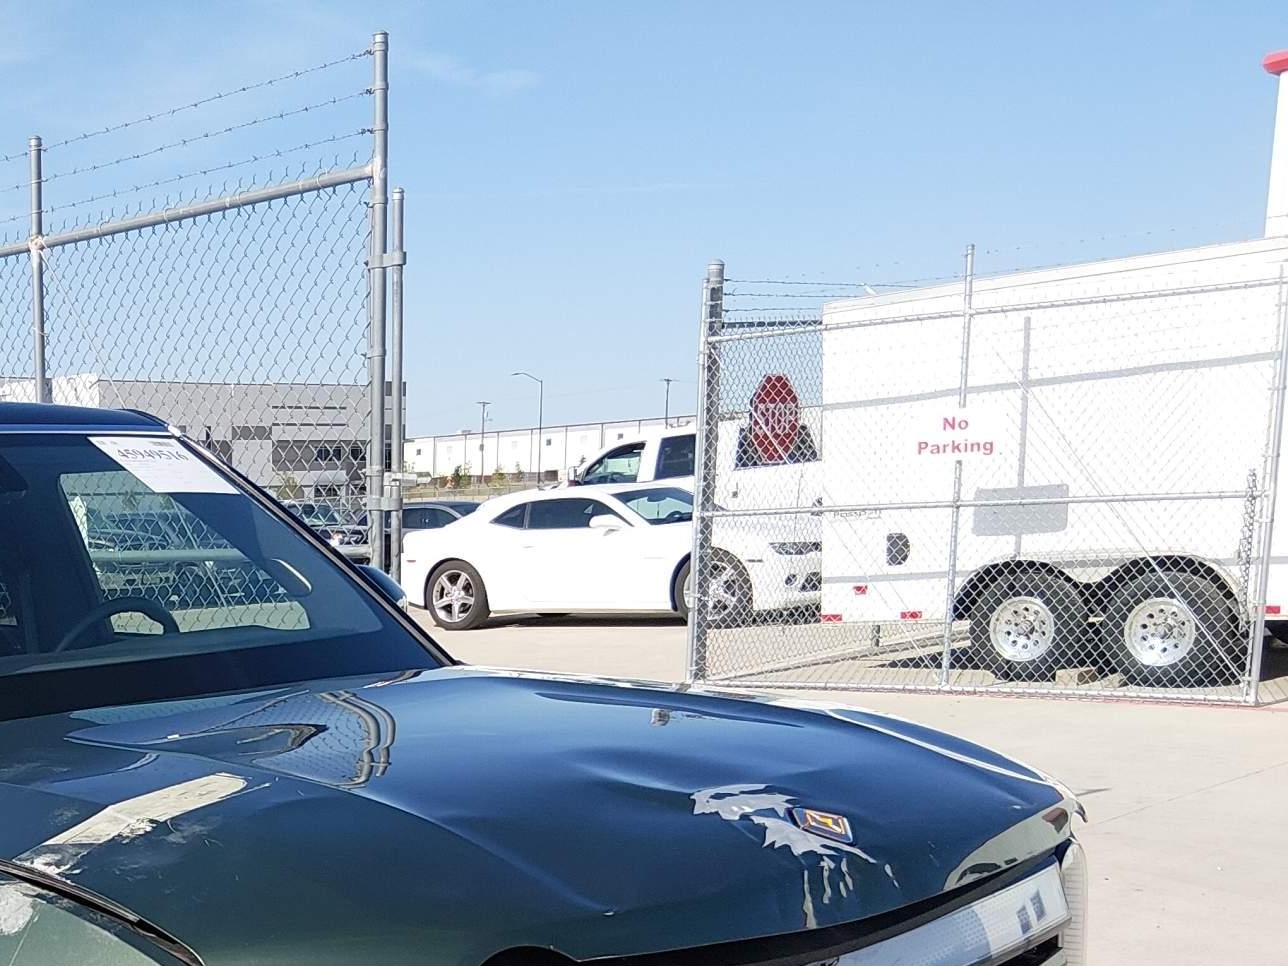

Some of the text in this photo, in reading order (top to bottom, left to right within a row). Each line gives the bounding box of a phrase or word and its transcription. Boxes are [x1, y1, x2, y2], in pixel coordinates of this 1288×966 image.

[757, 402, 796, 434] STOP
[942, 416, 969, 431] No
[116, 448, 190, 461] 45949516
[917, 439, 994, 455] Parking
